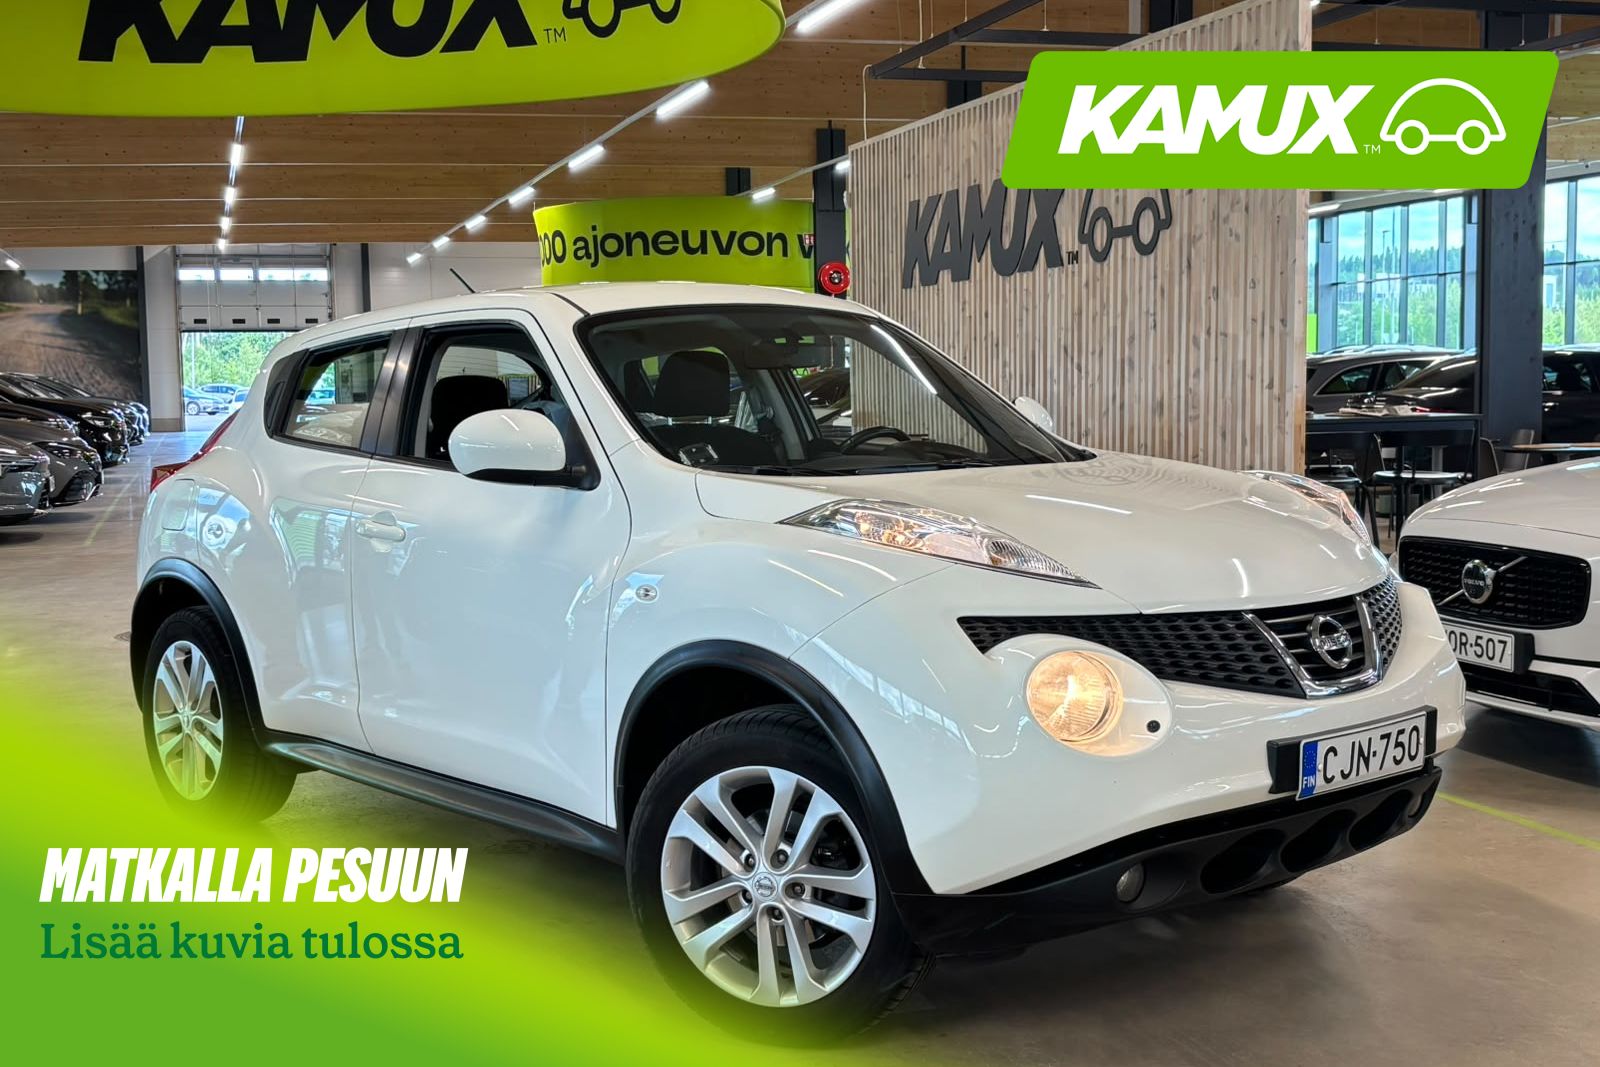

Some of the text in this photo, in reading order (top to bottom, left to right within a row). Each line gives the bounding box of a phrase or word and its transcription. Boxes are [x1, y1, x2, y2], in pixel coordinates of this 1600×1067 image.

[544, 27, 567, 43] TM
[572, 224, 789, 268] ajoneuvon
[902, 177, 1065, 289] KAMUX
[1445, 629, 1508, 663] OR-507
[1322, 725, 1420, 784] CJN-750
[1302, 775, 1316, 789] FIN
